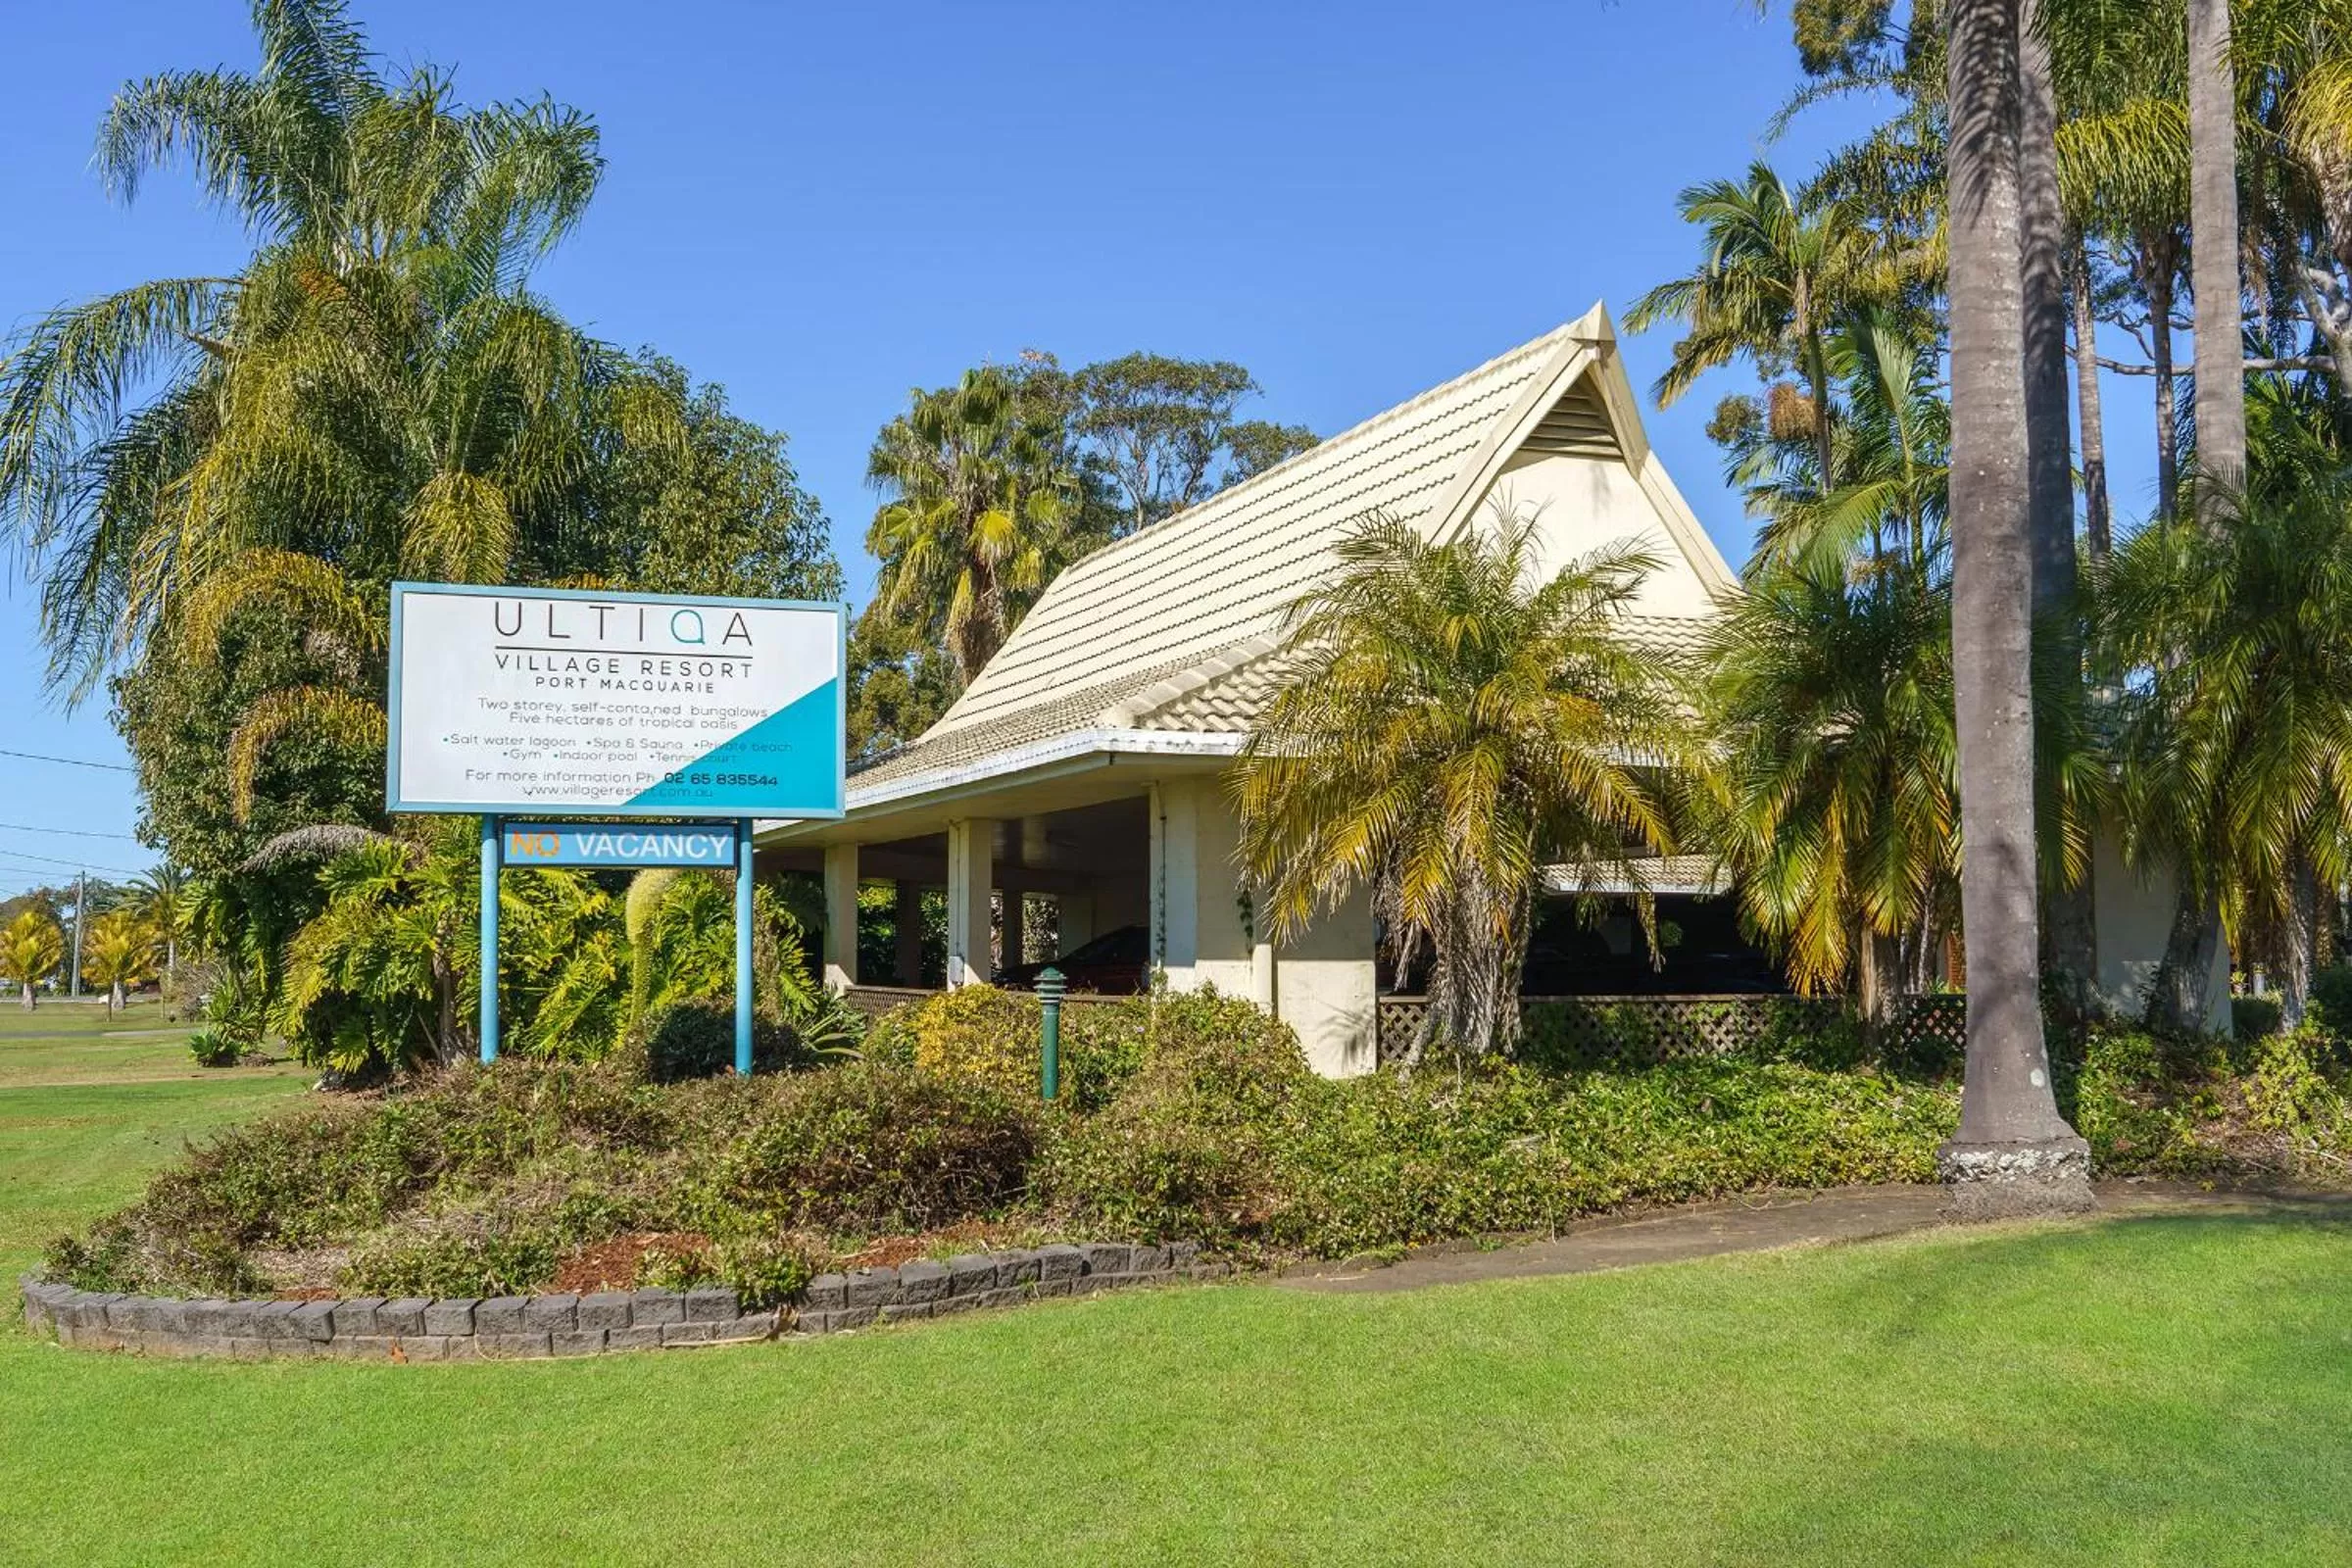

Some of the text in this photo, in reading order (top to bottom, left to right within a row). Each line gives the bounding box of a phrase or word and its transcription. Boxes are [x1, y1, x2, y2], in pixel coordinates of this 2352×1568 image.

[494, 600, 753, 647] ULTIQA
[495, 653, 753, 679] VILLAGE RESORT
[535, 676, 714, 694] PORT MACQUARIE
[478, 698, 509, 710] Two
[691, 704, 767, 720] bungalows
[510, 711, 738, 730] Five hectares of tropical oasis
[484, 735, 524, 746] water
[529, 736, 576, 751] lagoon
[625, 739, 635, 750] &
[640, 739, 683, 750] Sauna
[752, 741, 793, 753] beach
[608, 751, 637, 762] pool
[466, 769, 491, 781] For
[497, 771, 538, 782] more
[543, 770, 631, 783] information
[664, 772, 685, 784] 02
[691, 773, 710, 784] 65
[716, 773, 778, 786] 835544
[511, 830, 728, 858] NO VACANCY
